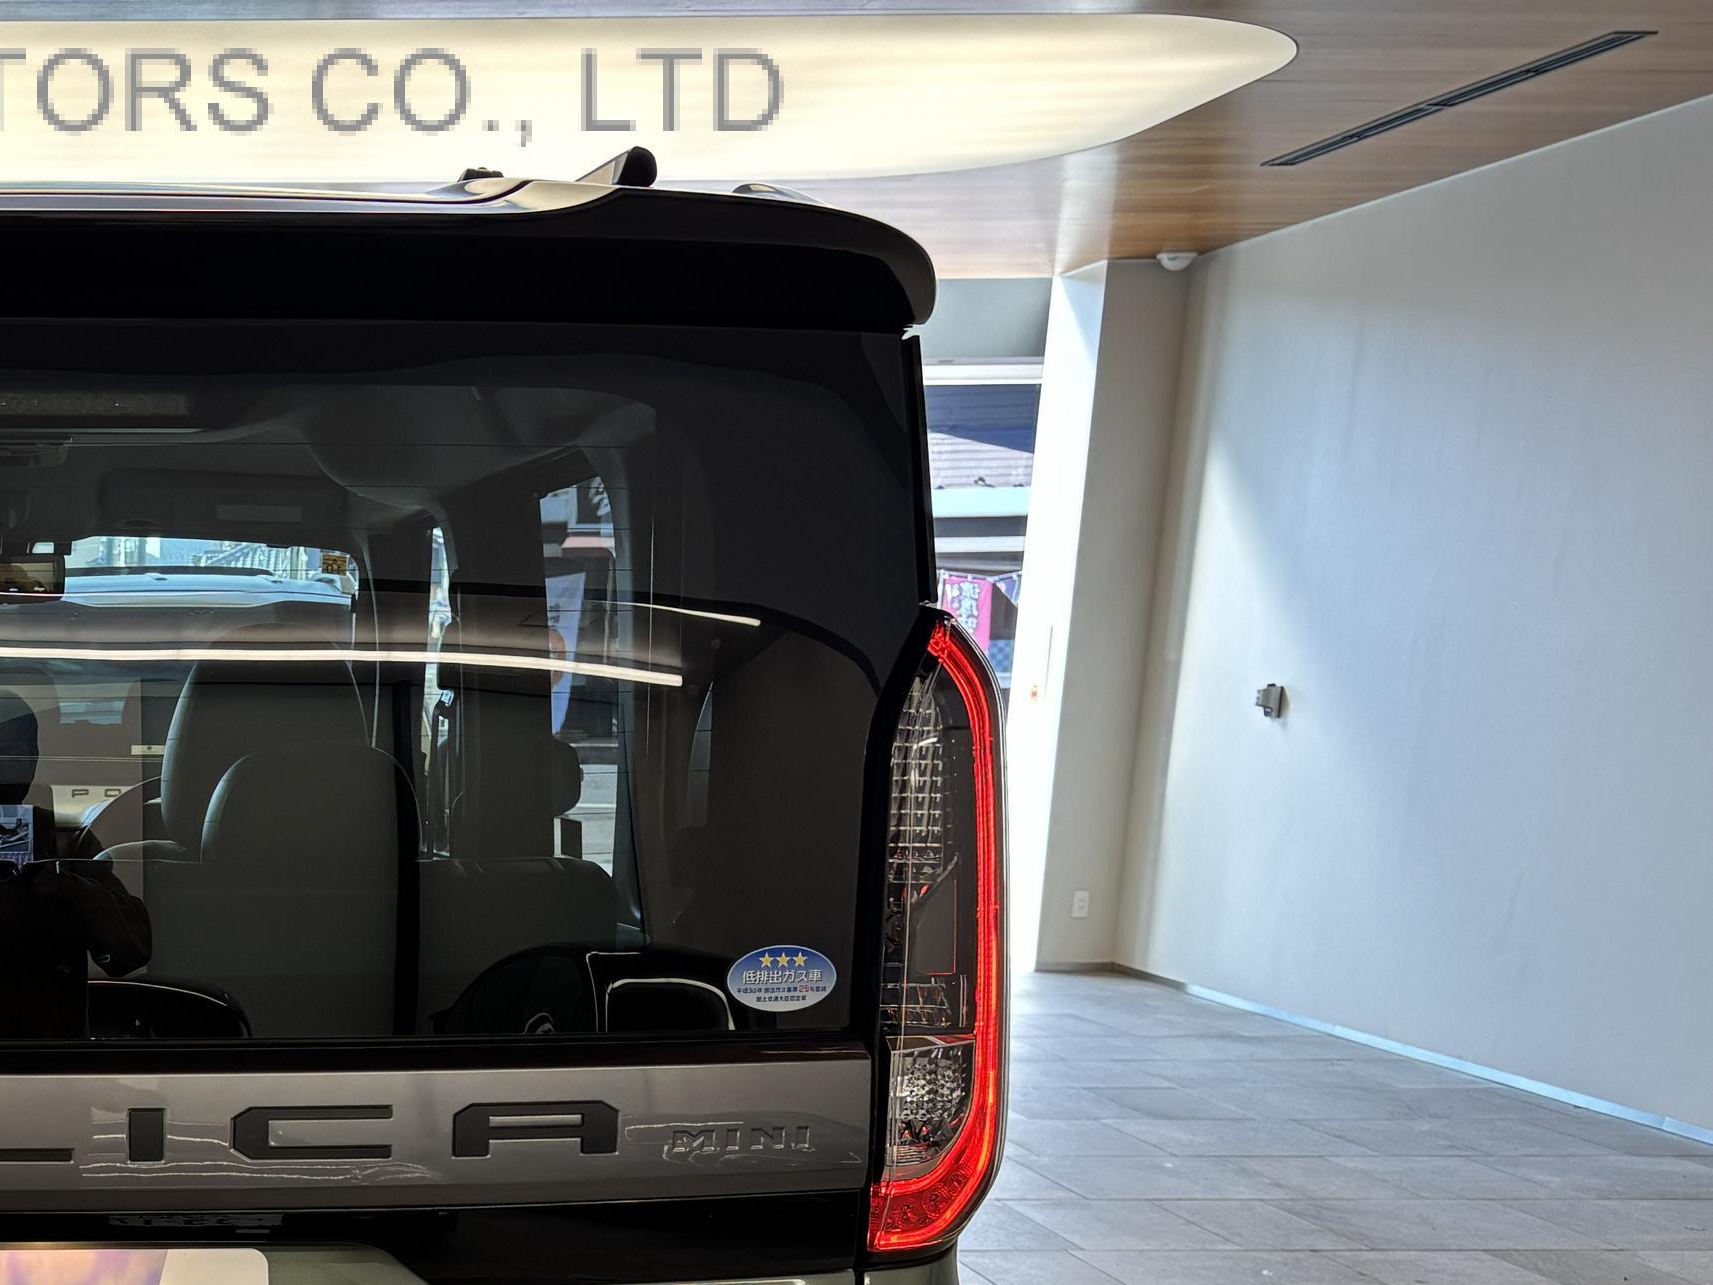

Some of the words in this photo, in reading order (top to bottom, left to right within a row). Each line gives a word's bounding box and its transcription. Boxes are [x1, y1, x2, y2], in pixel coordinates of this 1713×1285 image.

[742, 968, 824, 985] 低排出ガス車
[672, 1125, 811, 1153] MINI
